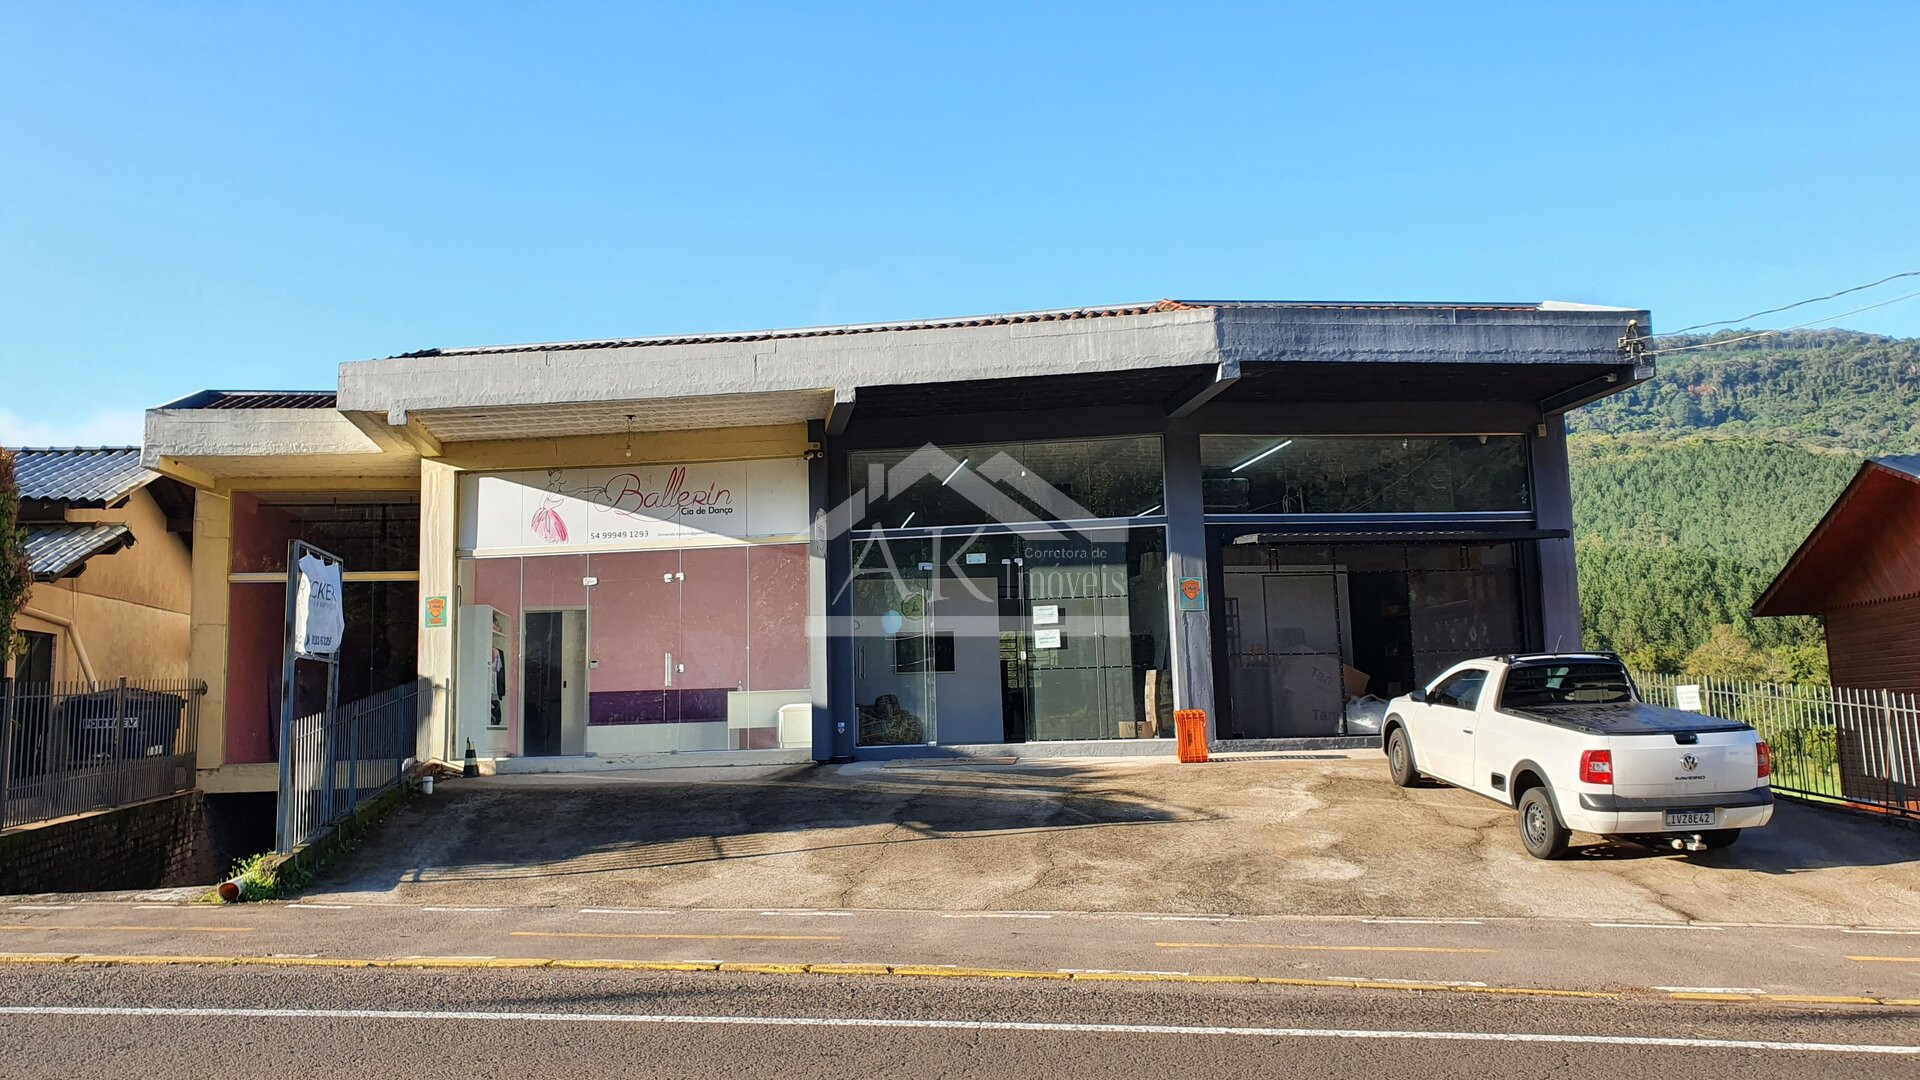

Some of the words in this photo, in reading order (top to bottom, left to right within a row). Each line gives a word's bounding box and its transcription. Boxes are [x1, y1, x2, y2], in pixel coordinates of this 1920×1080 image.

[681, 507, 694, 516] Cia
[696, 506, 706, 515] de
[708, 506, 733, 515] Dança
[590, 532, 600, 540] 54
[602, 531, 627, 539] 99949
[629, 530, 649, 538] 1293
[1671, 813, 1710, 825] IVZ8E42
